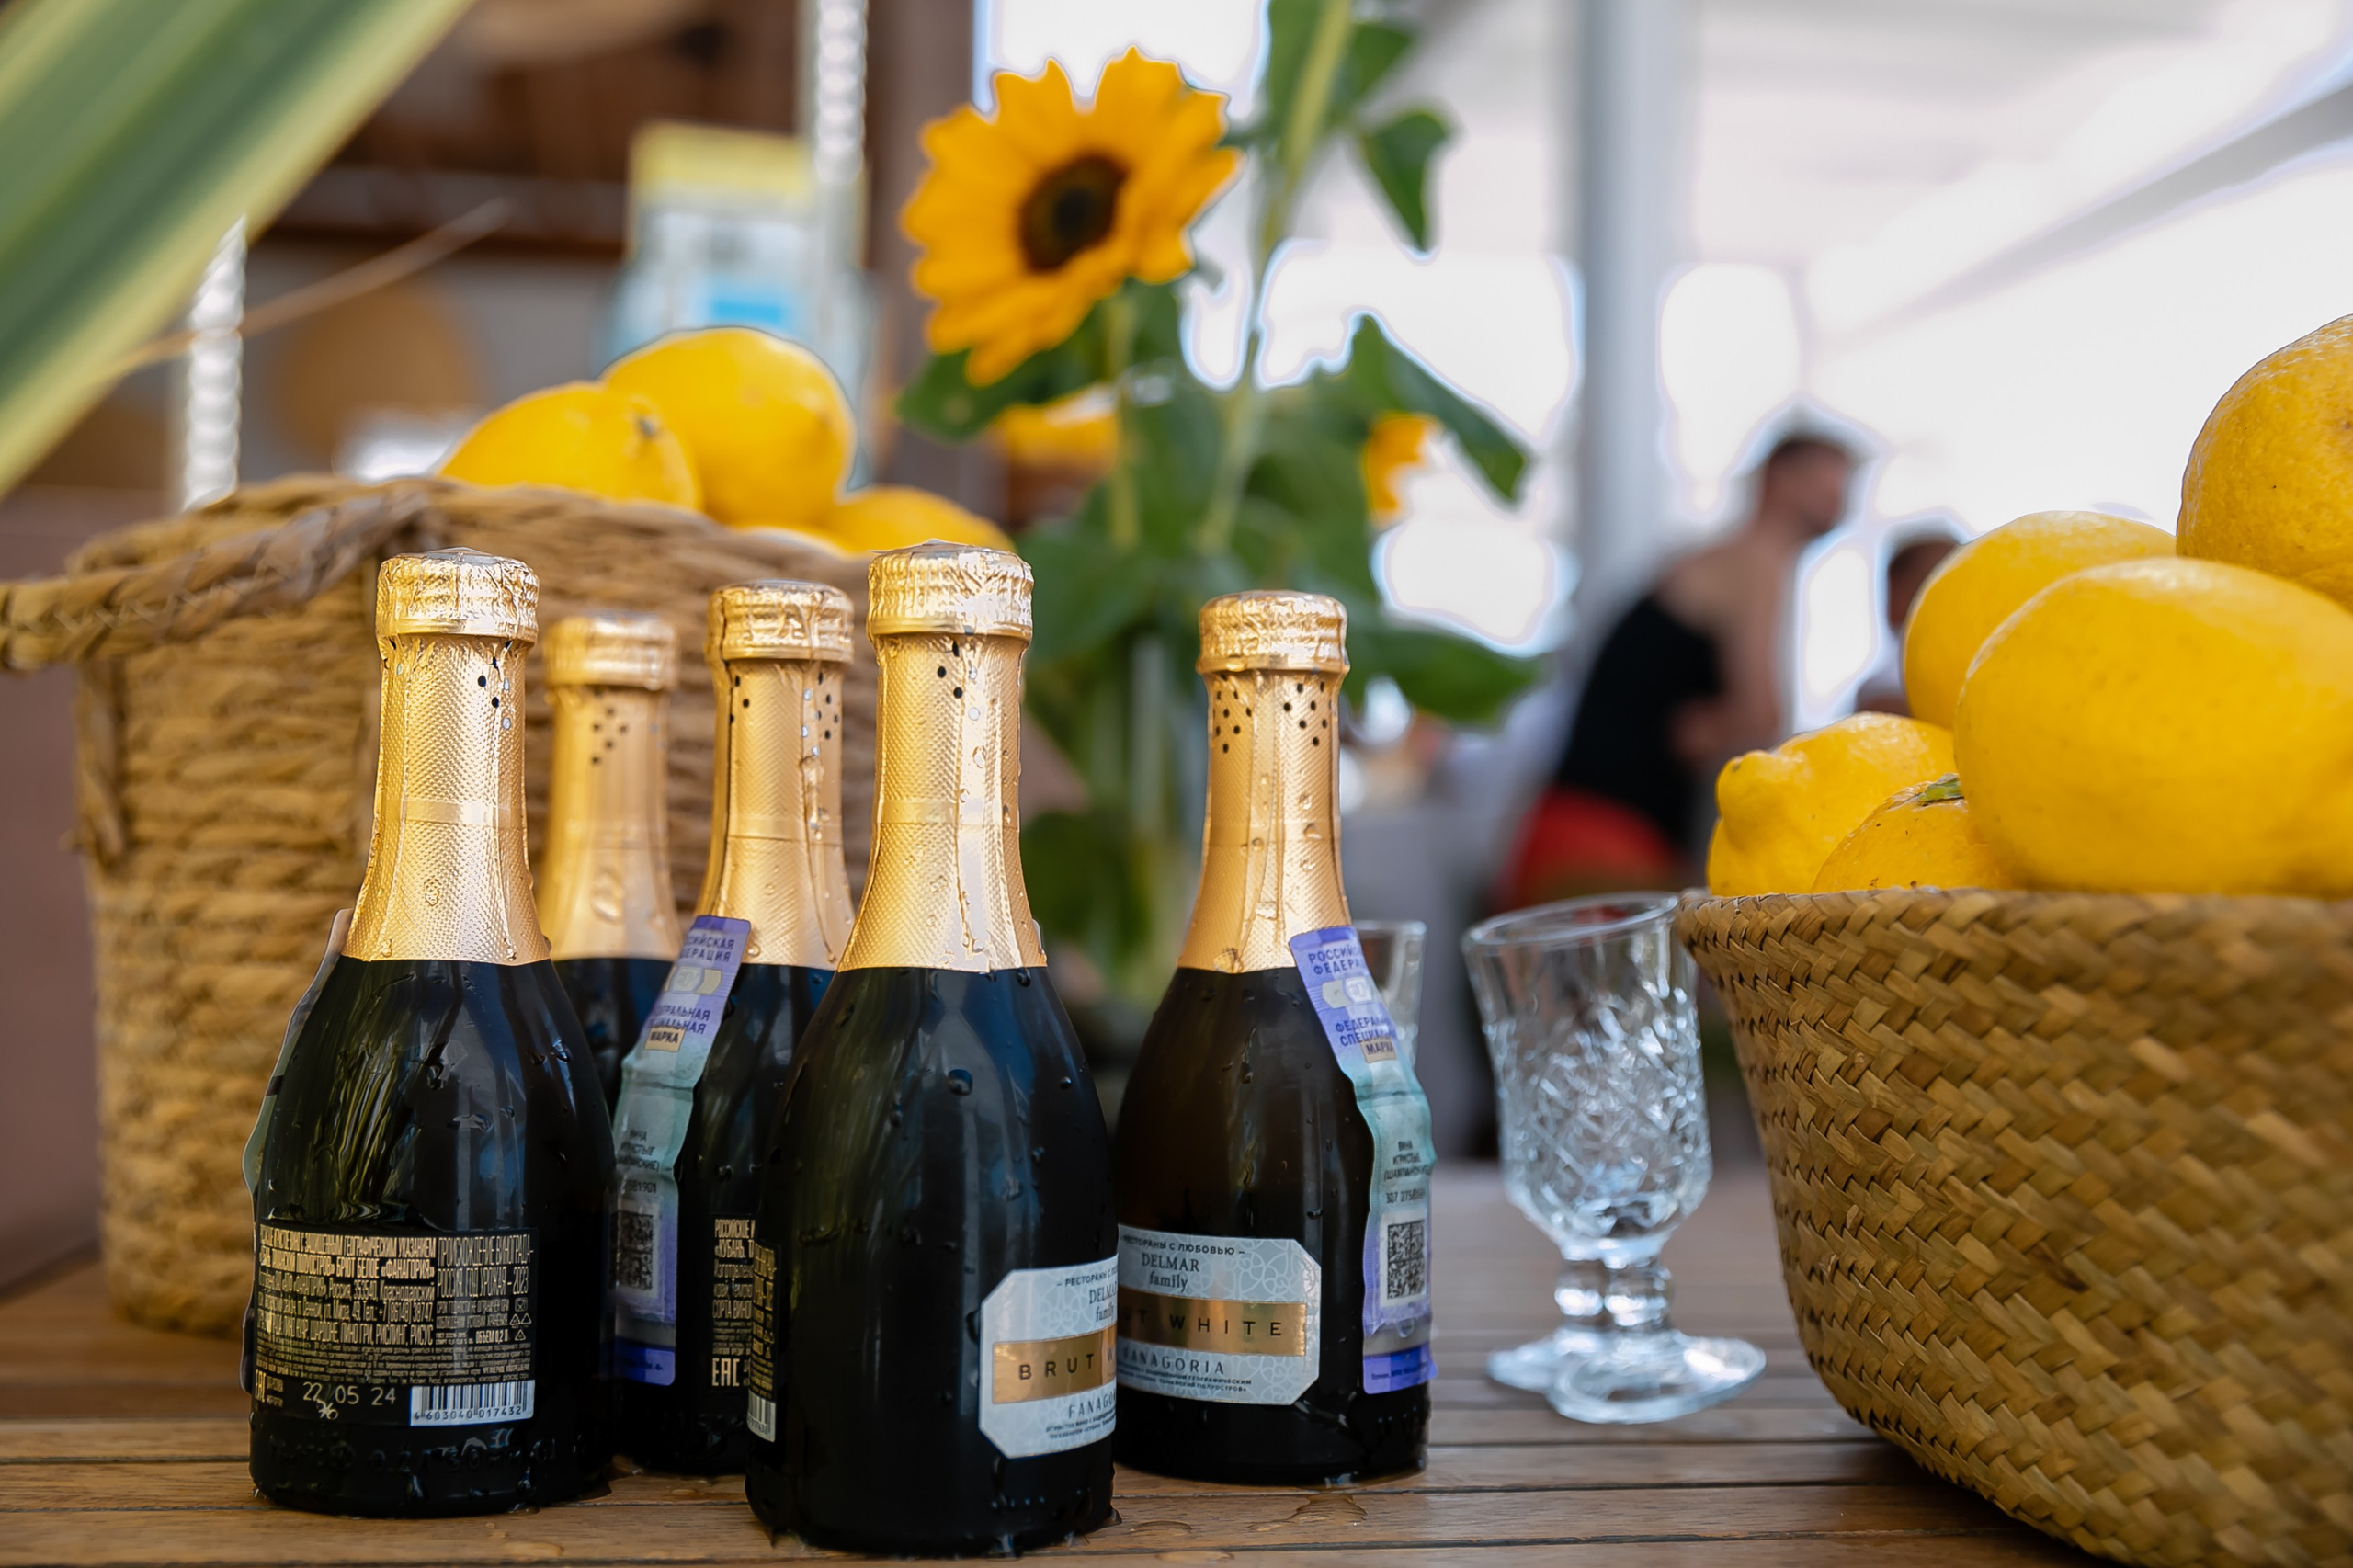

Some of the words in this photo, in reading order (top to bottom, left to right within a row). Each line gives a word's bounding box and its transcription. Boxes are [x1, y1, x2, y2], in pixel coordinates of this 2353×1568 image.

[1178, 1244, 1235, 1256] ЛЮБОВЬЮ
[357, 1257, 380, 1278] БЕЛОЕ
[381, 1257, 435, 1279] «ФАНАГОРИЯ»
[1141, 1251, 1200, 1273] DELMAR
[380, 1279, 435, 1301] Краснодарский
[513, 1266, 529, 1295] 2023
[1065, 1272, 1107, 1288] РЕСТОРАНЫ
[1149, 1269, 1188, 1293] family
[410, 1324, 434, 1346] РИСУС
[1169, 1312, 1282, 1337] WHITE
[475, 1330, 495, 1345] ОБЪЕМ
[1019, 1353, 1095, 1381] BRUT
[302, 1381, 323, 1401] 22
[335, 1385, 359, 1404] 05
[370, 1386, 396, 1406] 24
[1068, 1388, 1116, 1419] FANAGO
[426, 1410, 473, 1420] 603040
[478, 1405, 522, 1418] 017432
